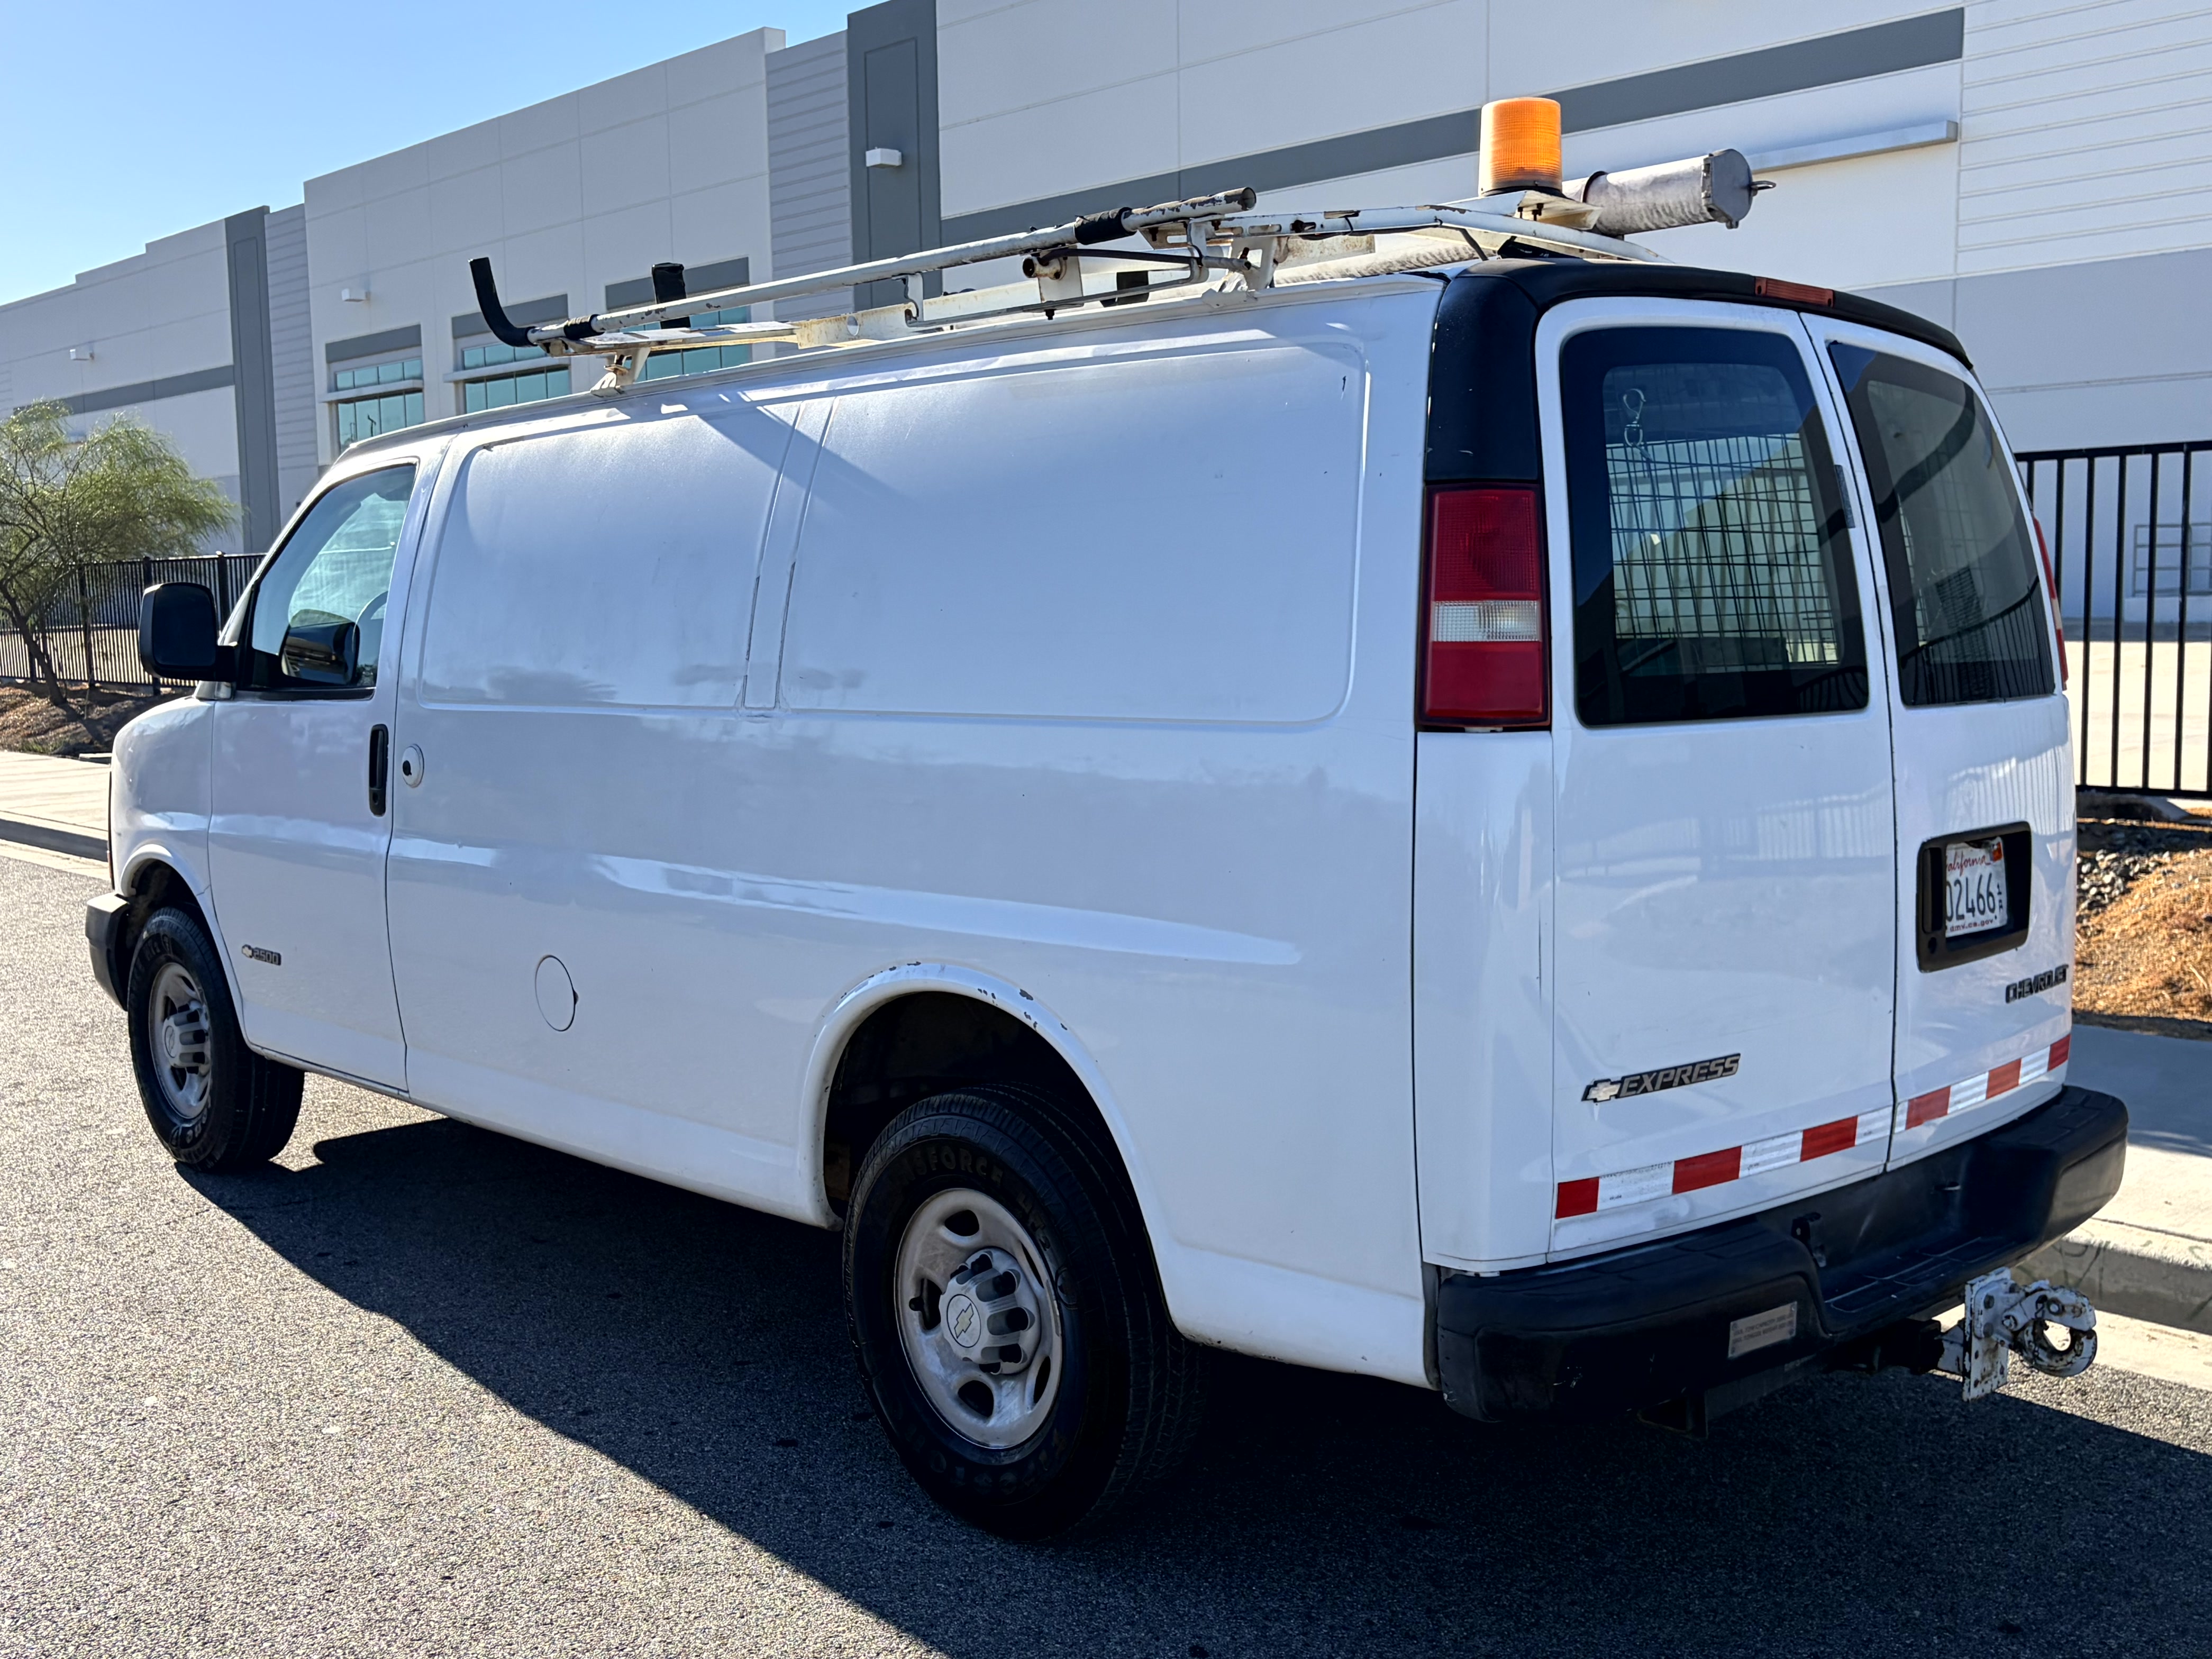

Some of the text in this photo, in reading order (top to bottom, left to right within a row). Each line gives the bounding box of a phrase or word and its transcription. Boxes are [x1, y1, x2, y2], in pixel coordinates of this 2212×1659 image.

[1947, 850, 1991, 877] alifornia
[1950, 919, 1993, 932] dmv.ca.gov
[253, 948, 280, 965] 2500
[2006, 964, 2069, 1003] CHEVROLET
[1619, 1055, 1741, 1098] EXPRESS
